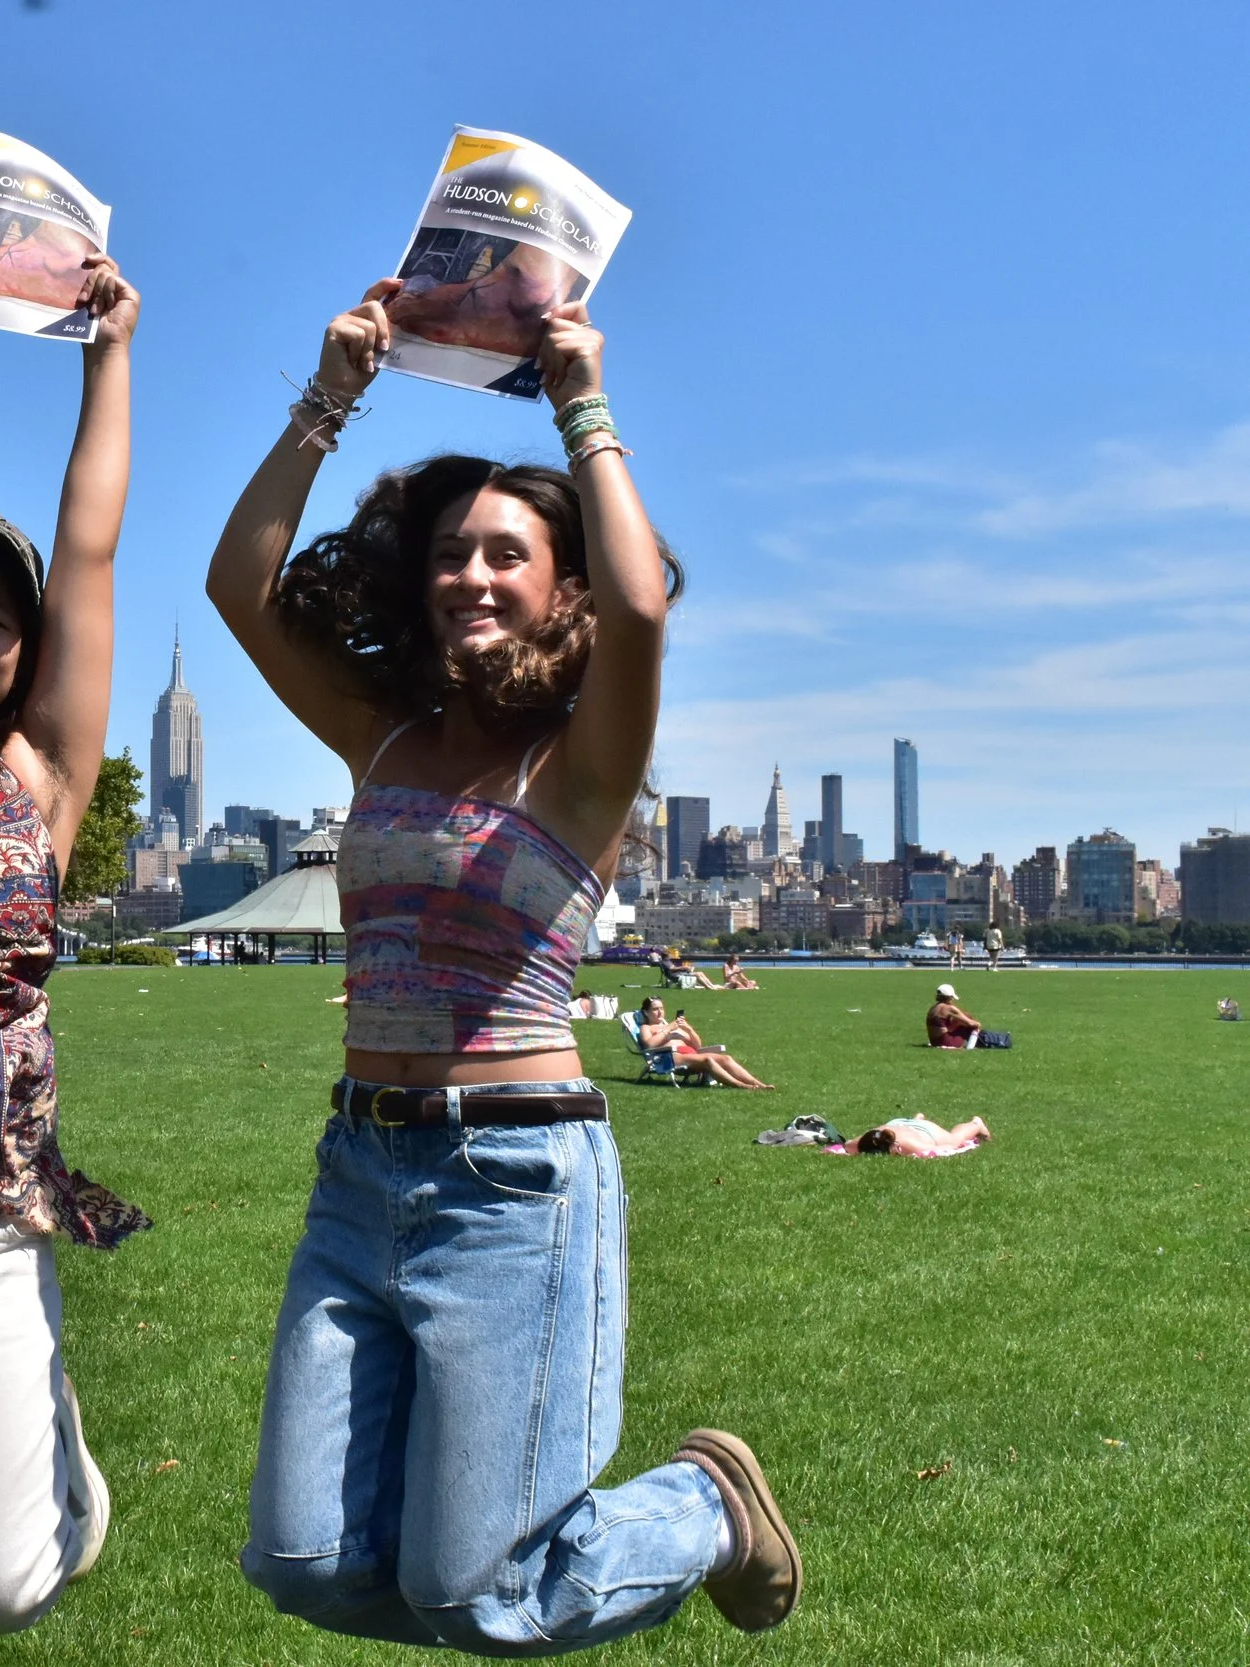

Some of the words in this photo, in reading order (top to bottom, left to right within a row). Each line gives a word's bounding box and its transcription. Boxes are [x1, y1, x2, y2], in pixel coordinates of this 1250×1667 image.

[450, 176, 463, 184] THE
[443, 184, 513, 207] HUDSON
[530, 202, 599, 255] SCHOLAR
[450, 208, 482, 218] student-run
[482, 213, 511, 224] magazine
[510, 218, 529, 228] based
[62, 324, 86, 333] $8.99
